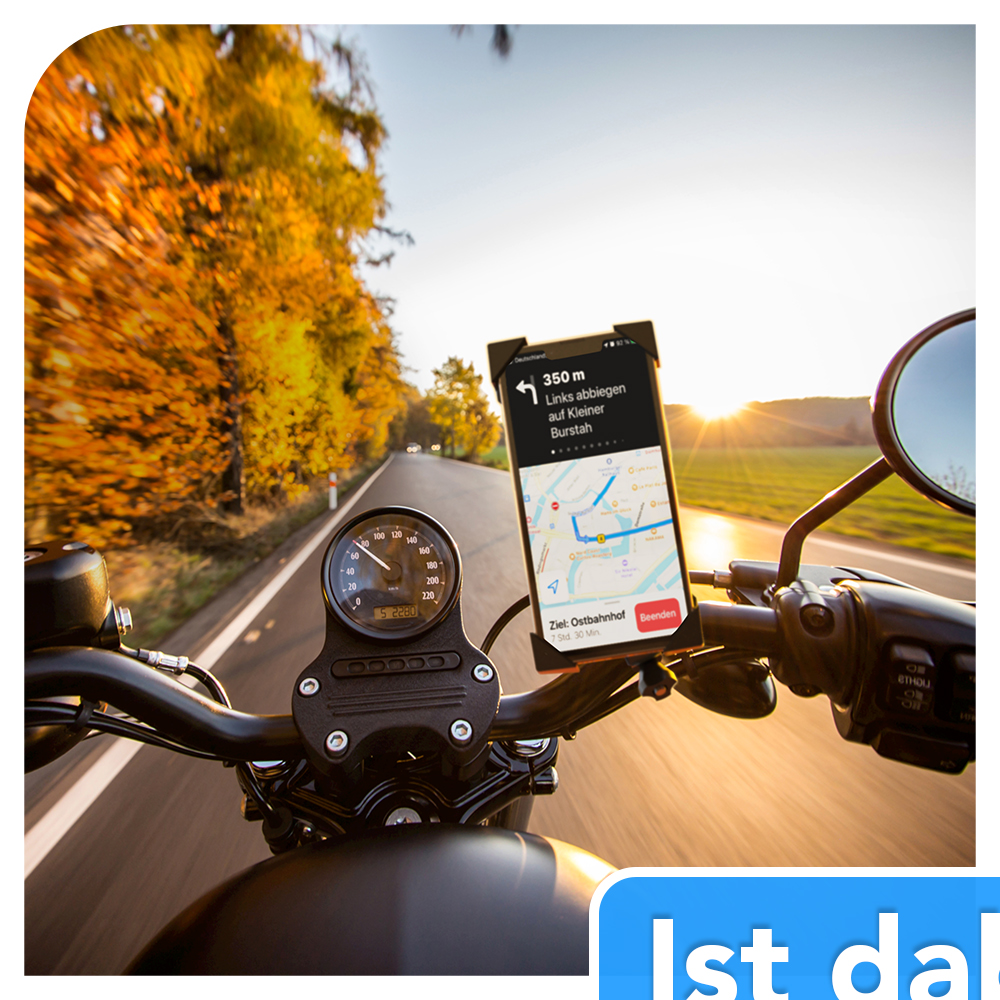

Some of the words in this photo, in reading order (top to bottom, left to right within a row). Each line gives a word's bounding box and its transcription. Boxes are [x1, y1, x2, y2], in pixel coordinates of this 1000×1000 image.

[542, 370, 570, 386] 350
[572, 370, 586, 382] m
[545, 392, 574, 406] Links
[576, 384, 626, 398] abbiegen
[548, 408, 566, 422] auf
[568, 404, 605, 420] Kleiner
[550, 422, 593, 439] Burstah
[374, 532, 386, 540] 100
[391, 530, 402, 538] 120
[360, 540, 370, 548] 80
[406, 536, 418, 544] 140
[418, 546, 430, 554] 160
[350, 552, 360, 560] 60
[426, 561, 438, 570] 180
[346, 568, 354, 576] 40
[426, 576, 440, 585] 200
[348, 582, 356, 590] 20
[422, 591, 434, 600] 220
[356, 598, 361, 606] 0
[392, 606, 416, 618] 2280
[640, 610, 677, 622] Beenden
[548, 620, 570, 631] Ziel:
[570, 610, 626, 627] Ostbahnhof
[550, 634, 556, 642] 7
[557, 632, 572, 642] Std.
[574, 631, 584, 639] 30
[585, 630, 602, 638] Min.
